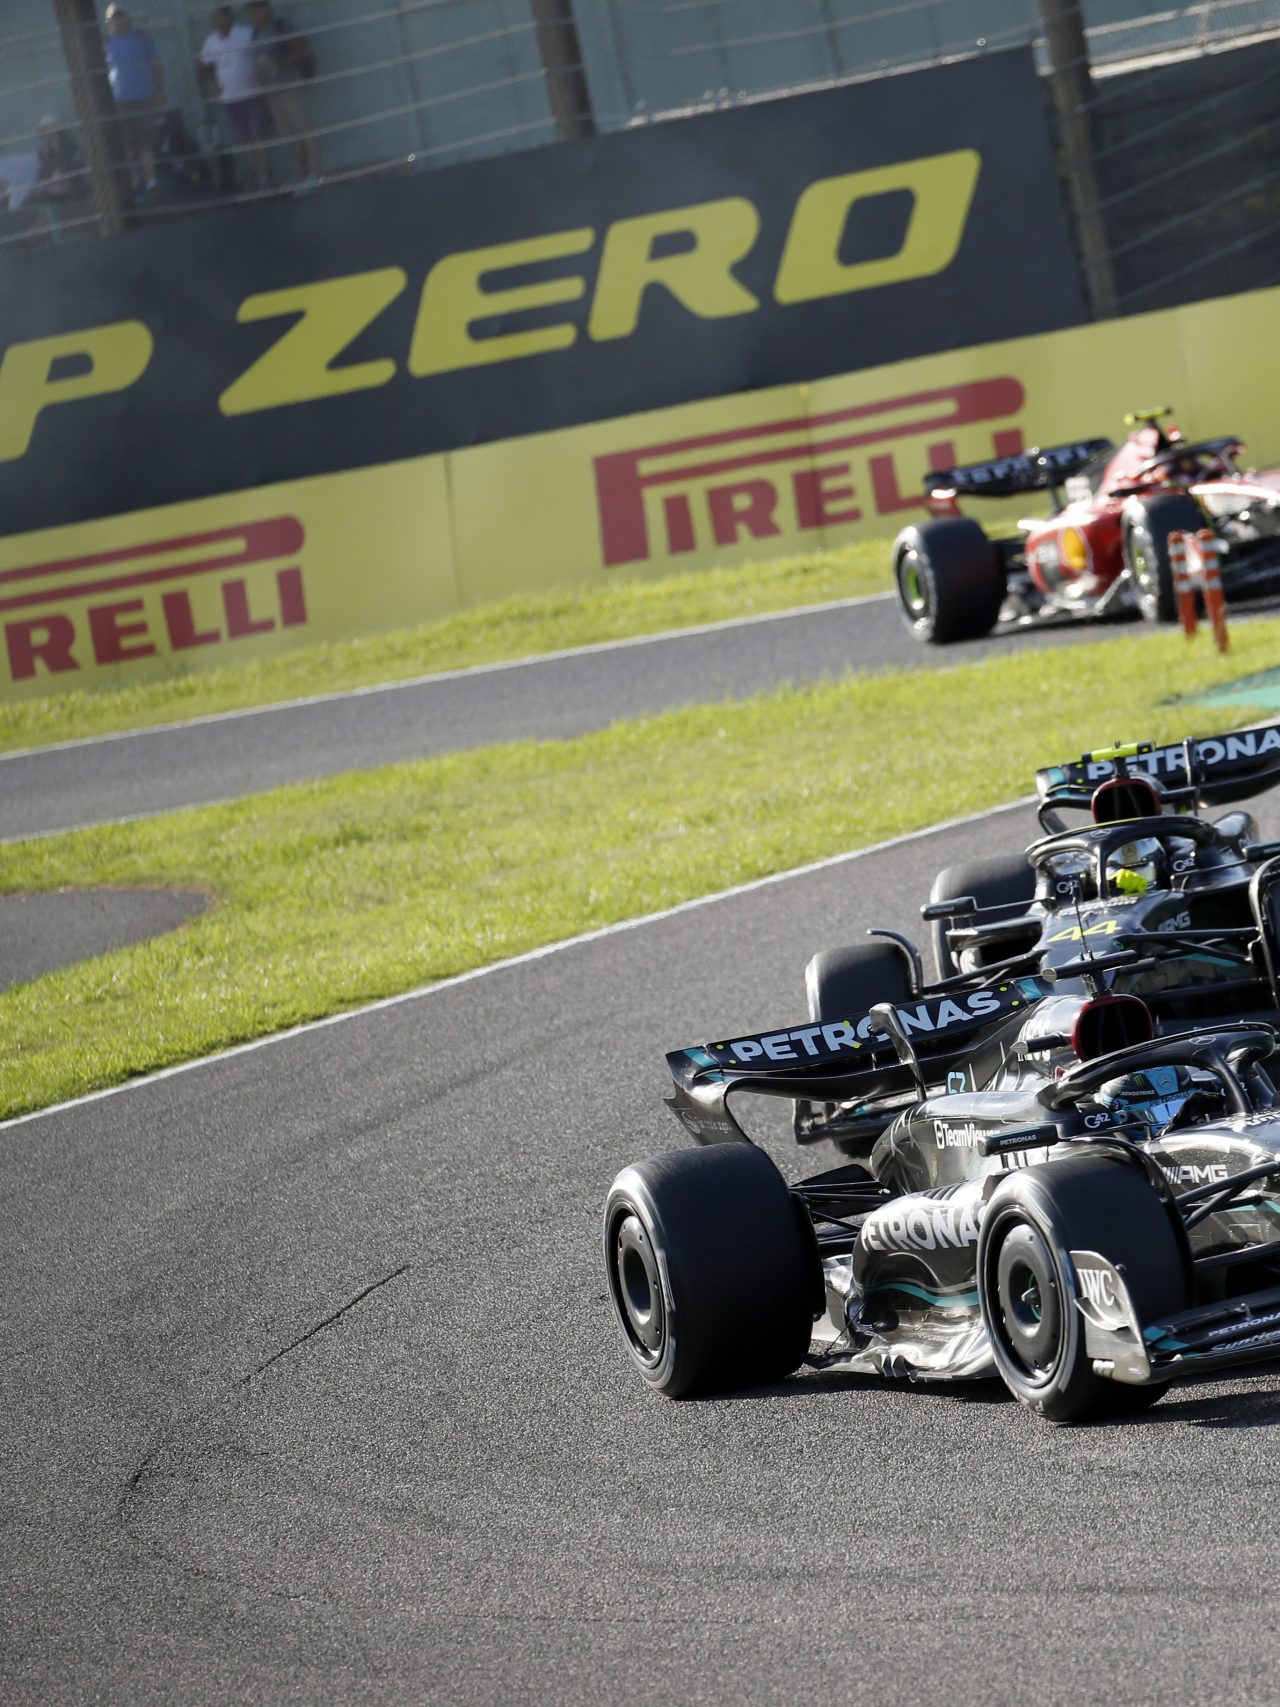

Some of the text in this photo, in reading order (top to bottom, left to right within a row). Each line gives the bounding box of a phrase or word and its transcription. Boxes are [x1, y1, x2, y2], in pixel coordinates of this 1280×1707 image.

[219, 150, 981, 416] ZERO
[1048, 920, 1122, 943] 44
[1084, 1112, 1112, 1129] G42
[1000, 1134, 1037, 1146] PETRONAS
[1077, 1268, 1115, 1306] IWC
